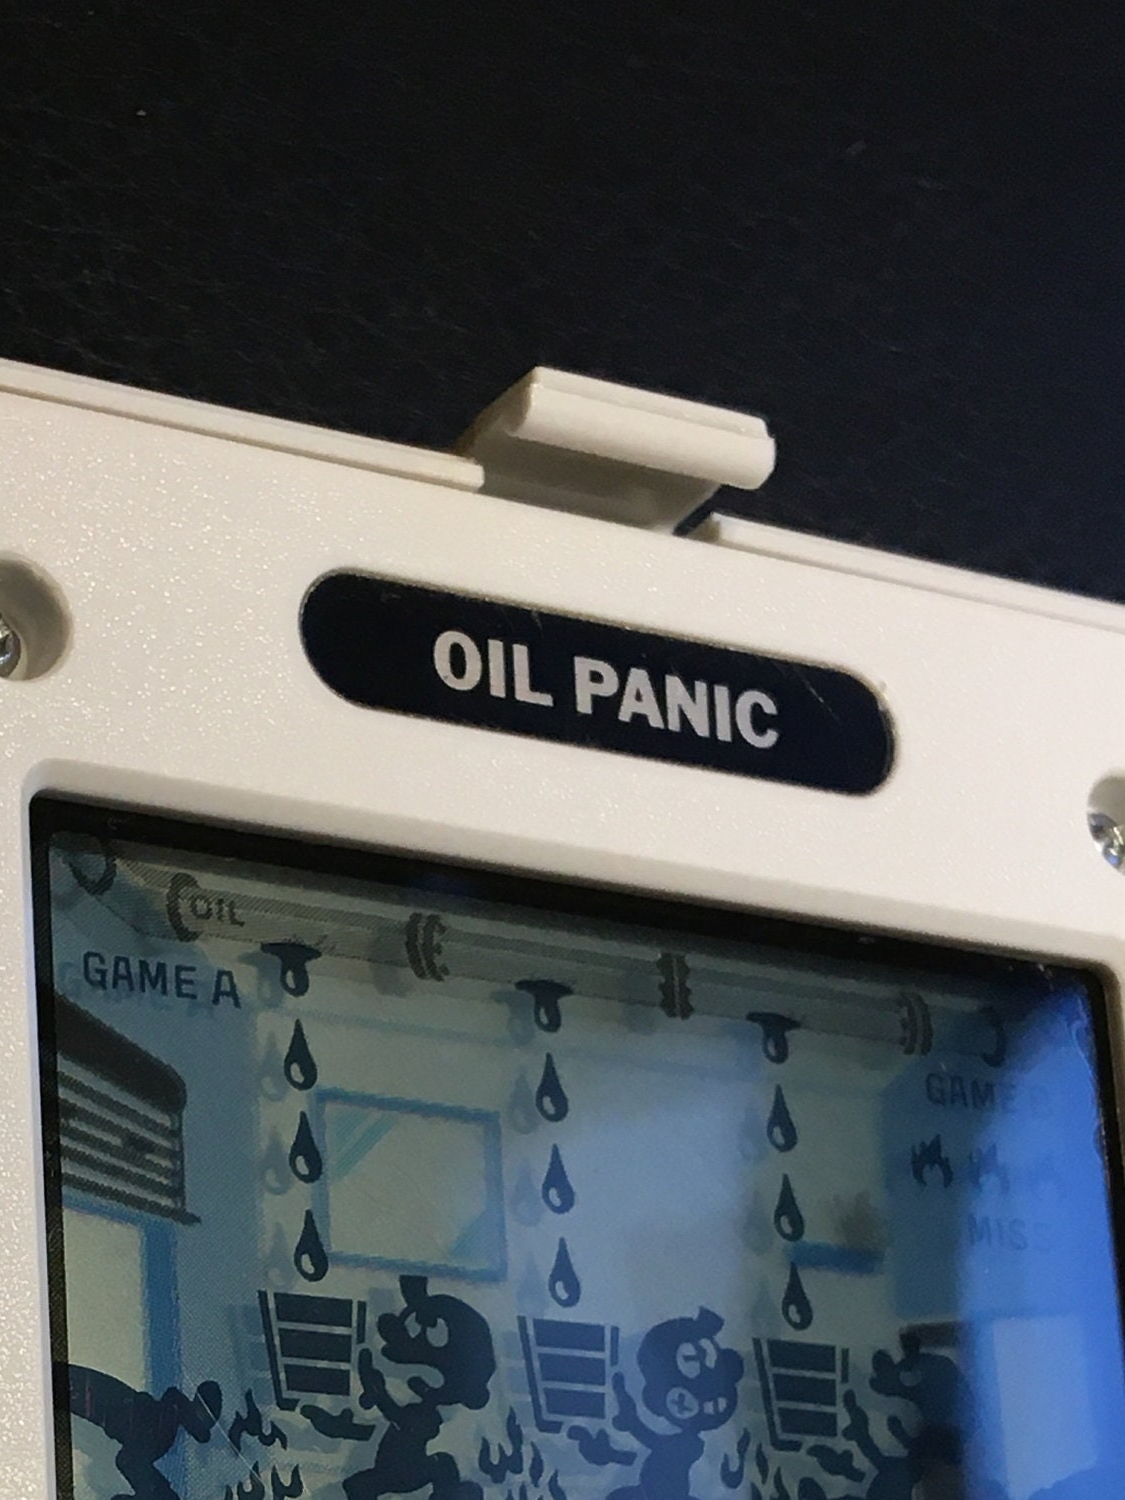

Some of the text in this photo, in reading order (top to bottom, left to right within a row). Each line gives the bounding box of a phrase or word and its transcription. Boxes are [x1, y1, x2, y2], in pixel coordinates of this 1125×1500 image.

[433, 630, 780, 749] OIL PANIC
[82, 950, 242, 1010] GAME A
[967, 1212, 1049, 1252] MIS
